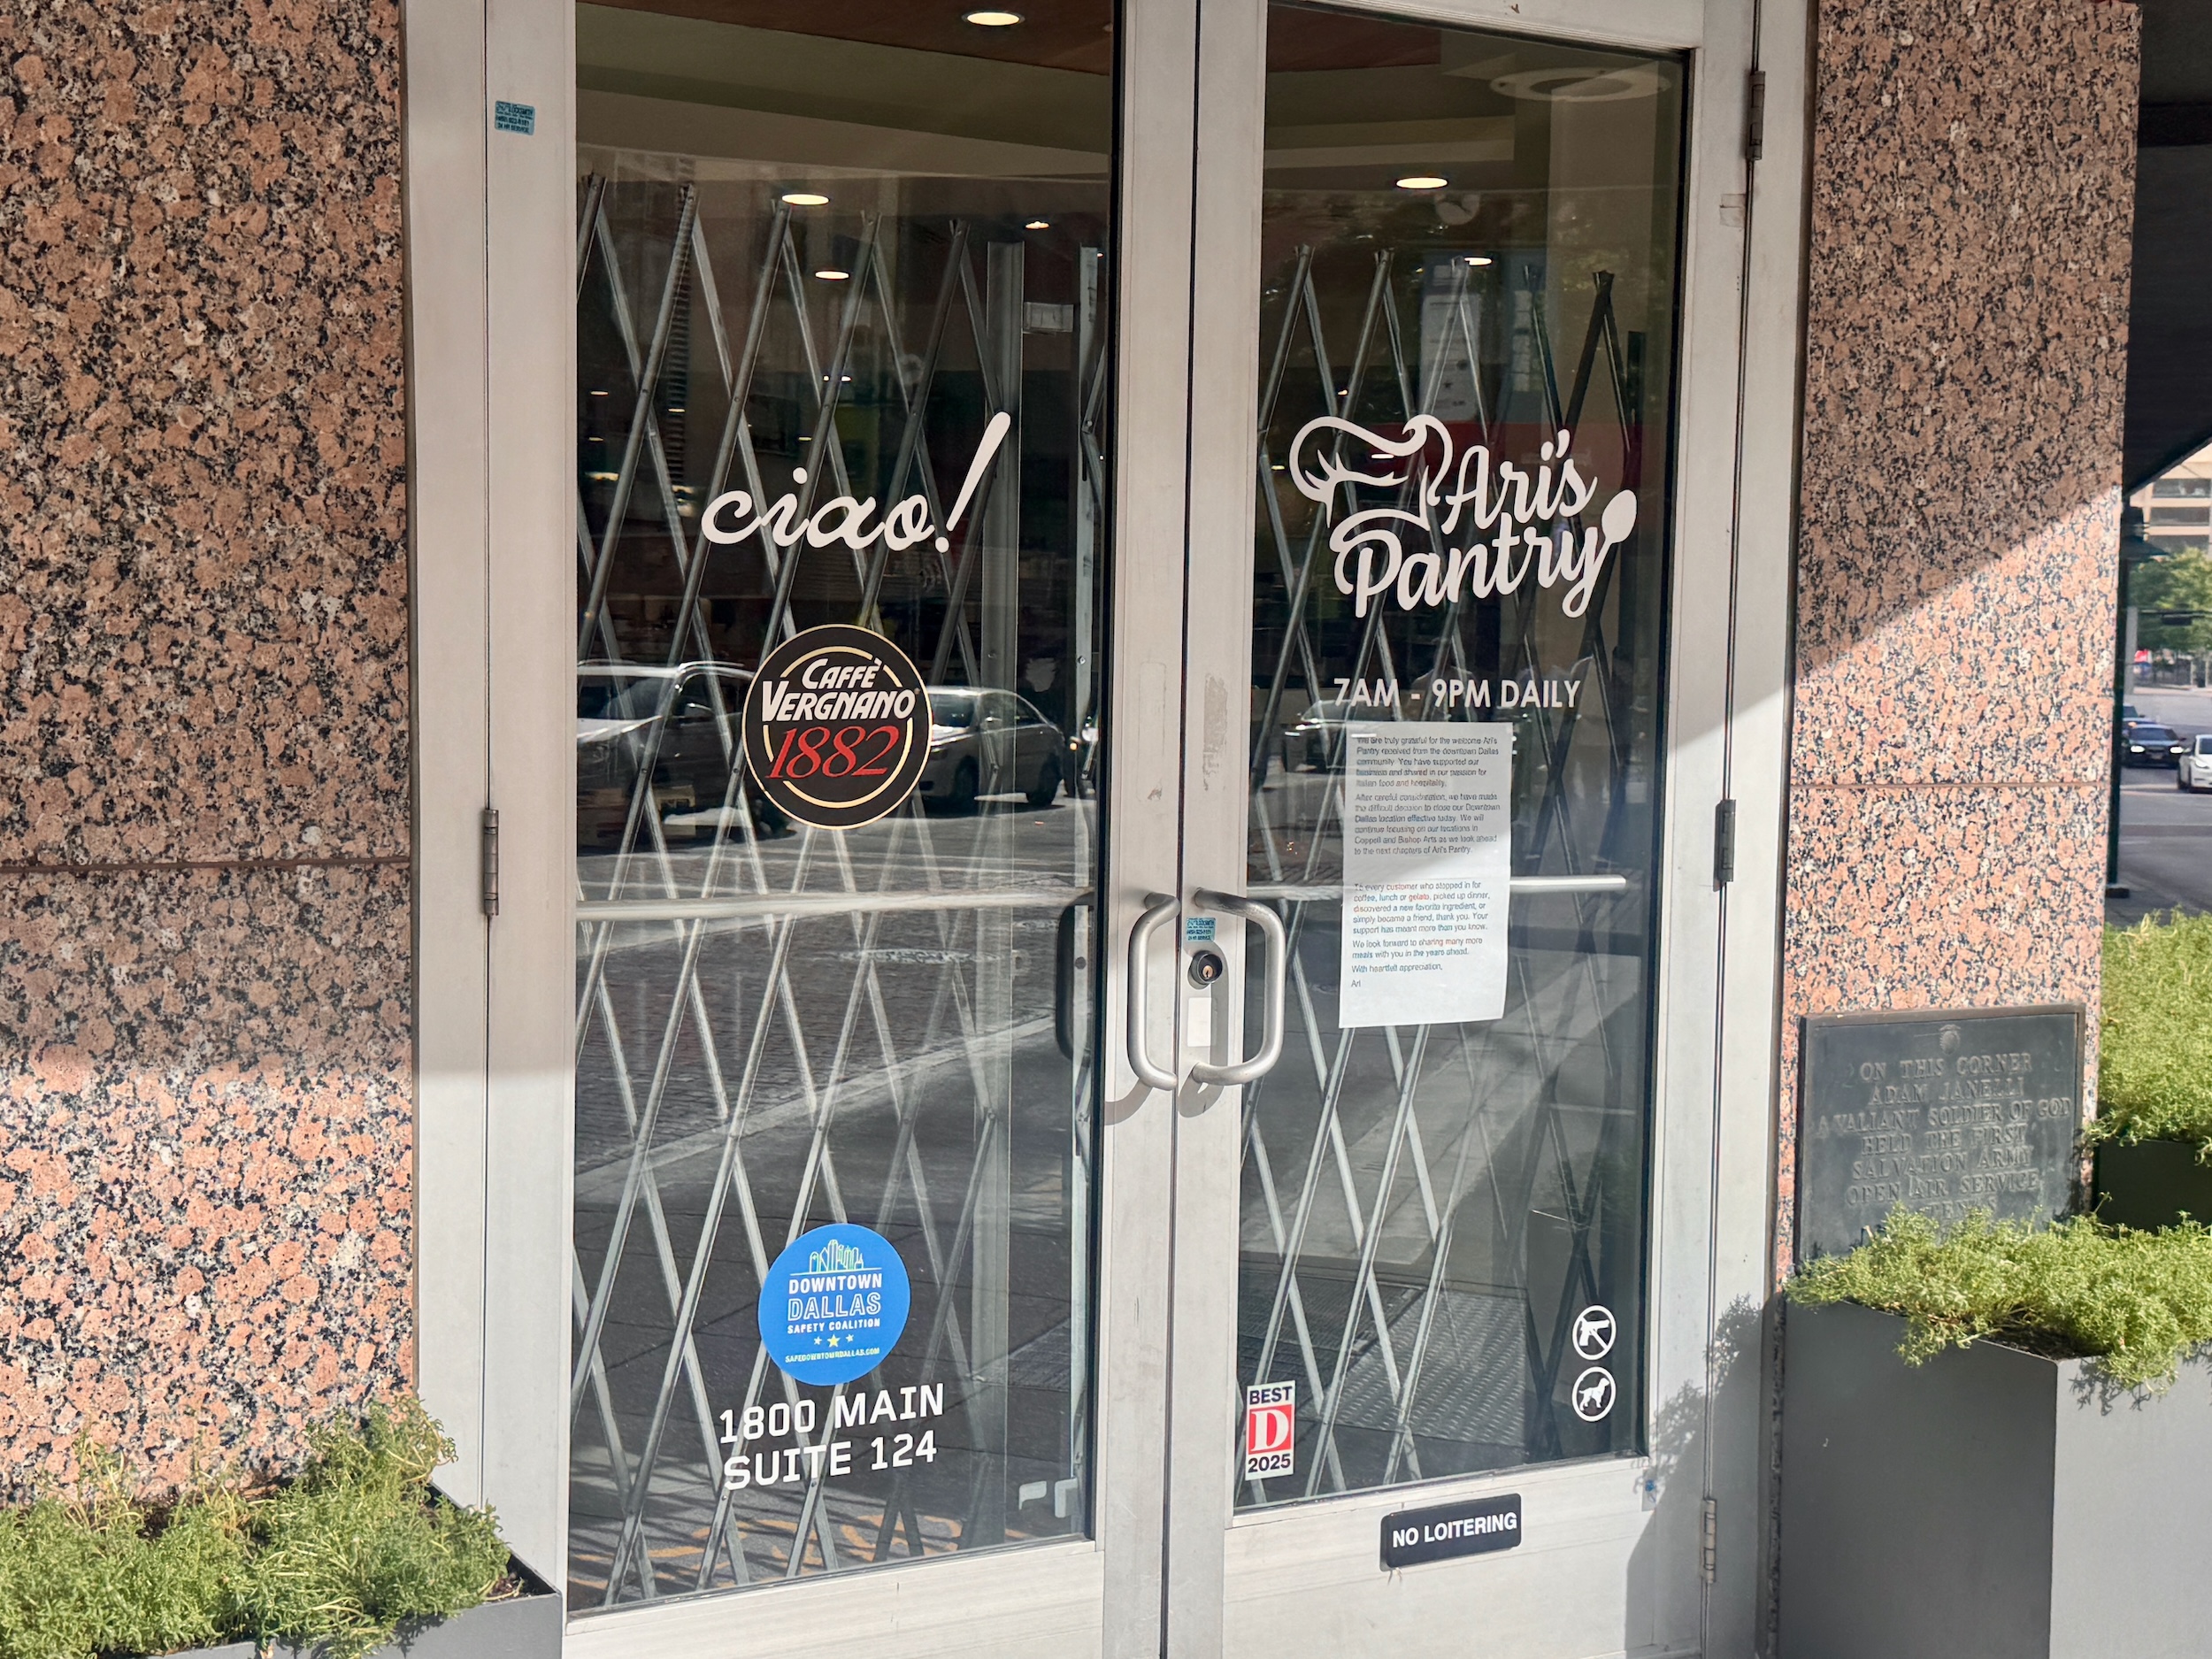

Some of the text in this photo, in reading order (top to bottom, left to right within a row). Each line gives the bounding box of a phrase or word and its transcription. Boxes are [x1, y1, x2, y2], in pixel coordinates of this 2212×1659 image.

[701, 411, 1010, 553] ciao!
[1441, 429, 1598, 535] Ari's
[1334, 512, 1601, 618] Pantry
[762, 680, 916, 721] VERGNANO
[1333, 678, 1400, 707] 7AM
[1432, 680, 1490, 707] 9PM
[1501, 680, 1581, 707] DAILY
[765, 726, 900, 779] 1882
[1385, 737, 1399, 746] truly
[1353, 916, 1375, 925] simply
[1353, 926, 1379, 935] support
[1860, 1053, 2032, 1081] ON THIS CORNER
[1869, 1078, 2024, 1106] ADAM JANELLI
[1833, 1110, 1919, 1133] VALIANT
[1928, 1102, 2002, 1126] SOLDIER
[2008, 1100, 2032, 1120] OF
[2038, 1098, 2071, 1118] GOD
[1862, 1123, 2027, 1156] HELD THE FIRST
[1853, 1146, 2034, 1180] SALVATION ARMY
[1847, 1183, 1901, 1206] OPEN
[1960, 1169, 2038, 1194] SERVICE
[789, 1273, 882, 1294] DOWNTOWN
[787, 1293, 881, 1321] DALLAS
[787, 1318, 880, 1333] SAFETY COALITION
[1249, 1386, 1293, 1405] BEST
[719, 1383, 943, 1444] 1800 MAIN
[1250, 1409, 1289, 1451] D
[724, 1430, 937, 1491] SUITE 124
[1248, 1454, 1290, 1473] 2025
[1393, 1512, 1517, 1548] NO LOITERING
